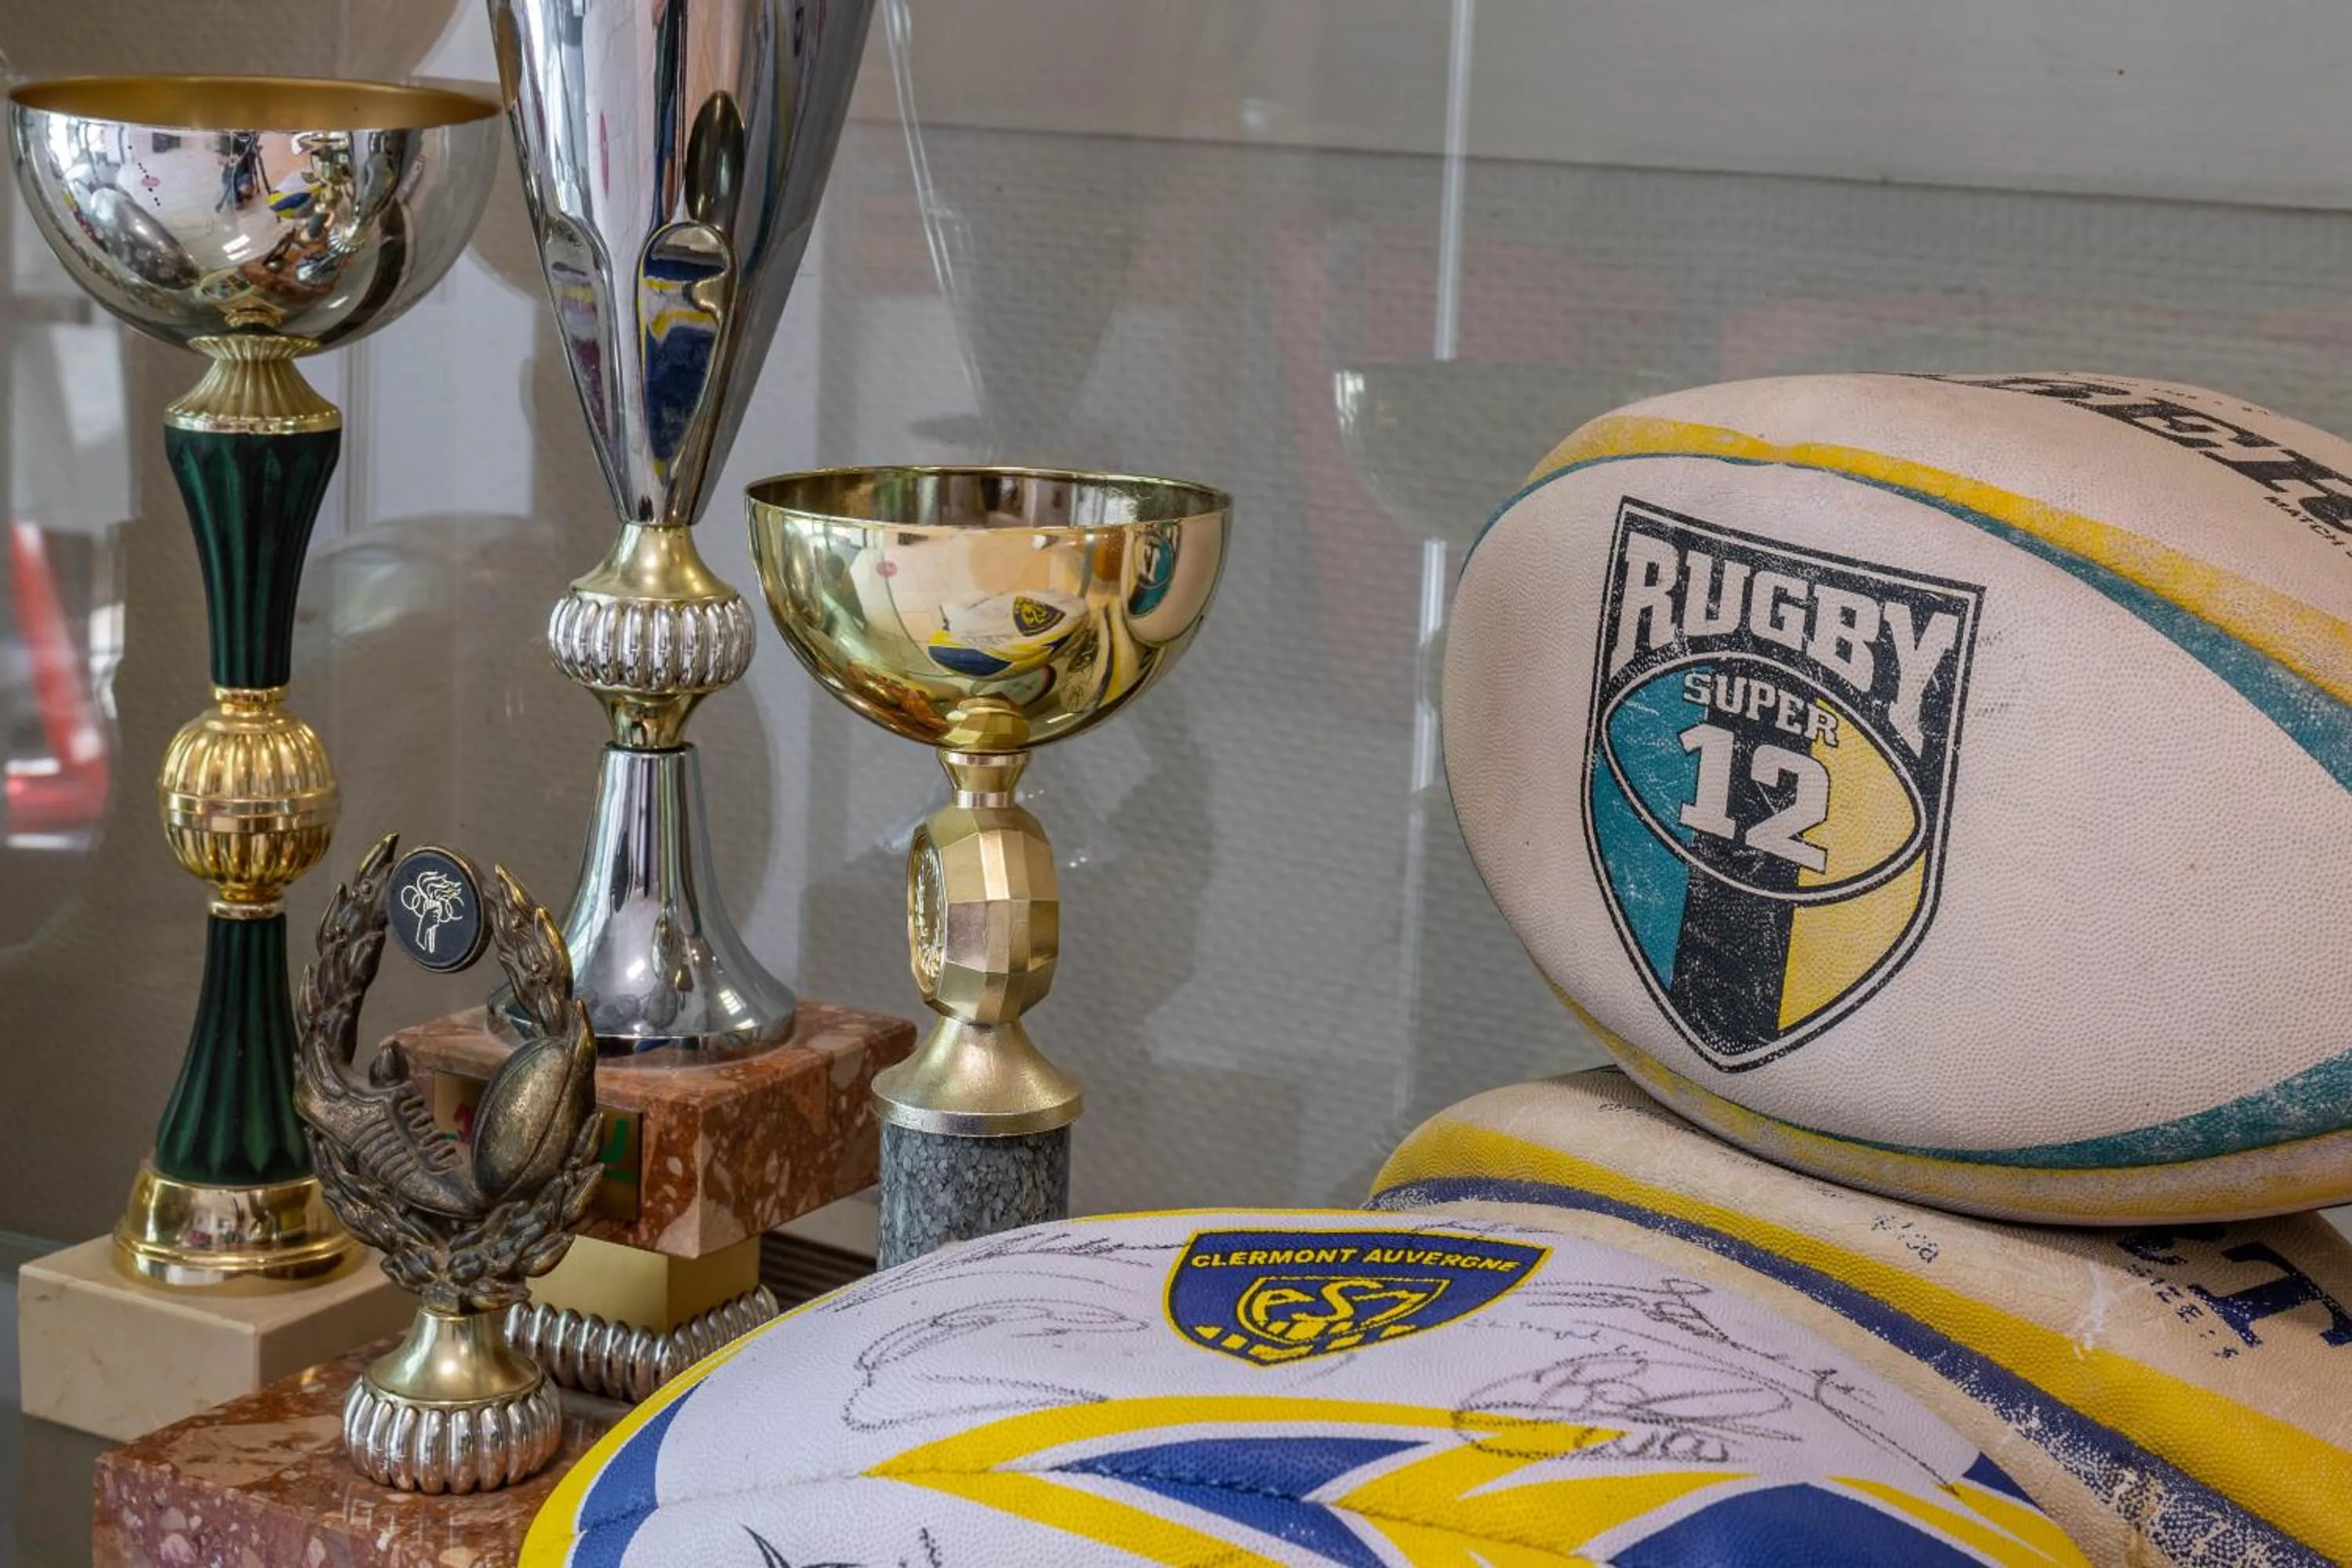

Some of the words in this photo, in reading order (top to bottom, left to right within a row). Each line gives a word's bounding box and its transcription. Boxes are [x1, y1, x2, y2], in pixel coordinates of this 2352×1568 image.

[2263, 495, 2346, 546] MATCH
[1610, 530, 1960, 759] RUGBY
[1682, 673, 1839, 747] SUPER
[1677, 721, 1831, 875] 12
[1190, 1247, 1359, 1269] CLERMONT
[1363, 1247, 1522, 1273] AUVERGNE
